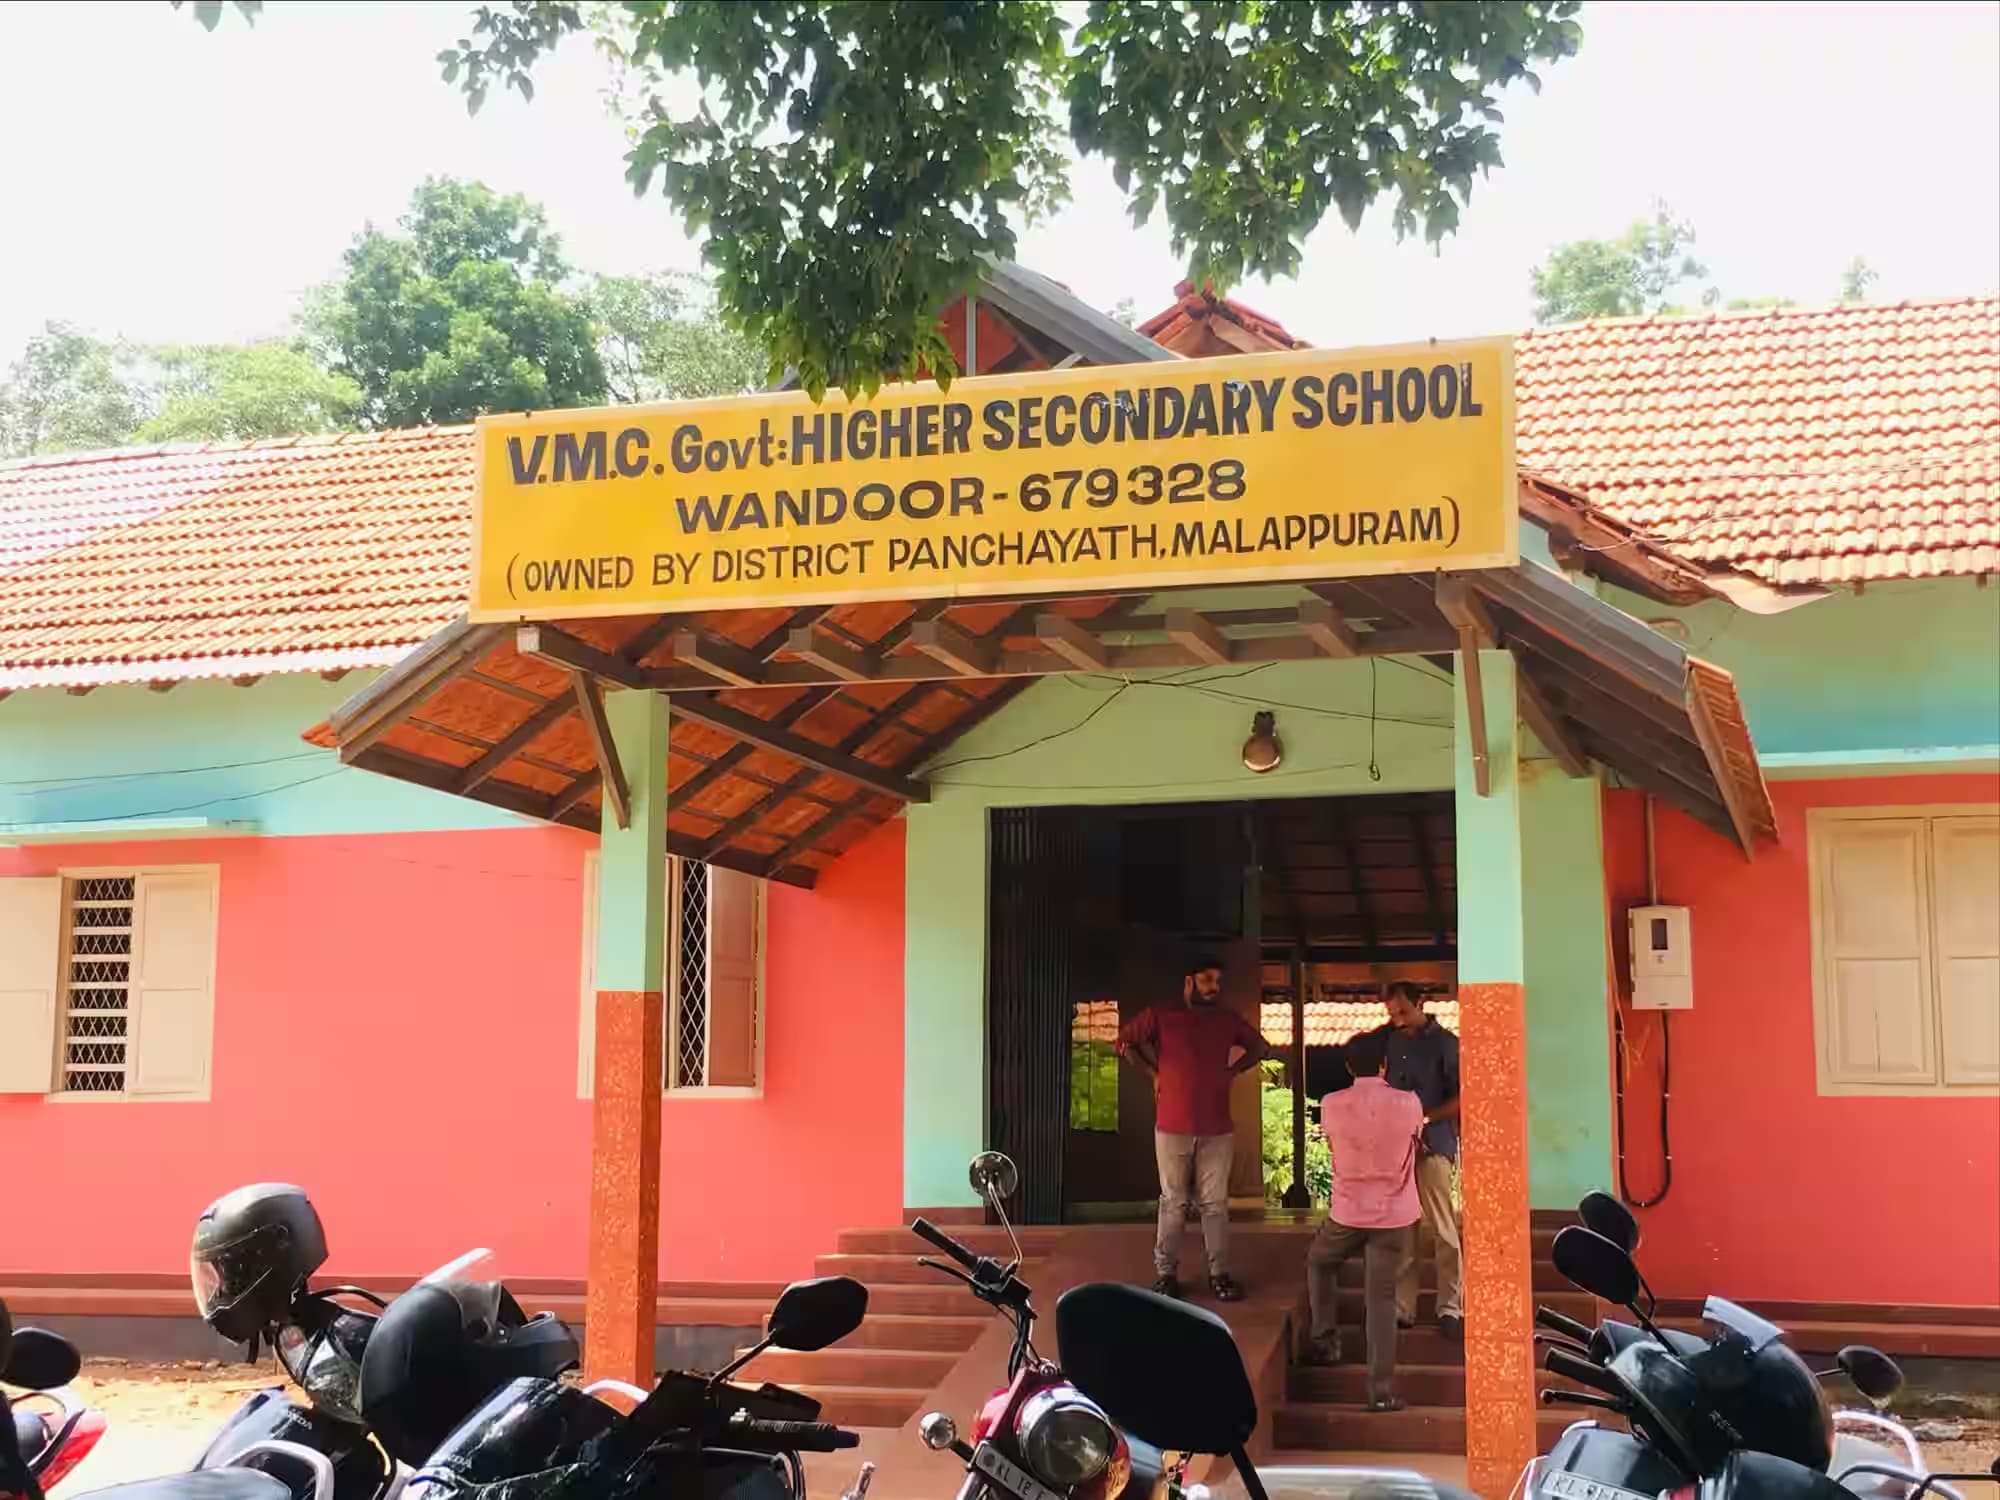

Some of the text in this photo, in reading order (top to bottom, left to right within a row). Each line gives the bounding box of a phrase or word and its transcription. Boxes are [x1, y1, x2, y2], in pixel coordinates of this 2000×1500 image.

[506, 427, 665, 485] V.M.C.
[791, 402, 973, 466] HIGHER
[982, 377, 1286, 451] SECONDARY
[1291, 362, 1483, 428] SCHOOL
[1019, 459, 1247, 513] 679328
[506, 553, 633, 600] (OWNED
[652, 552, 702, 585] BY
[712, 539, 874, 582] DISTRICT
